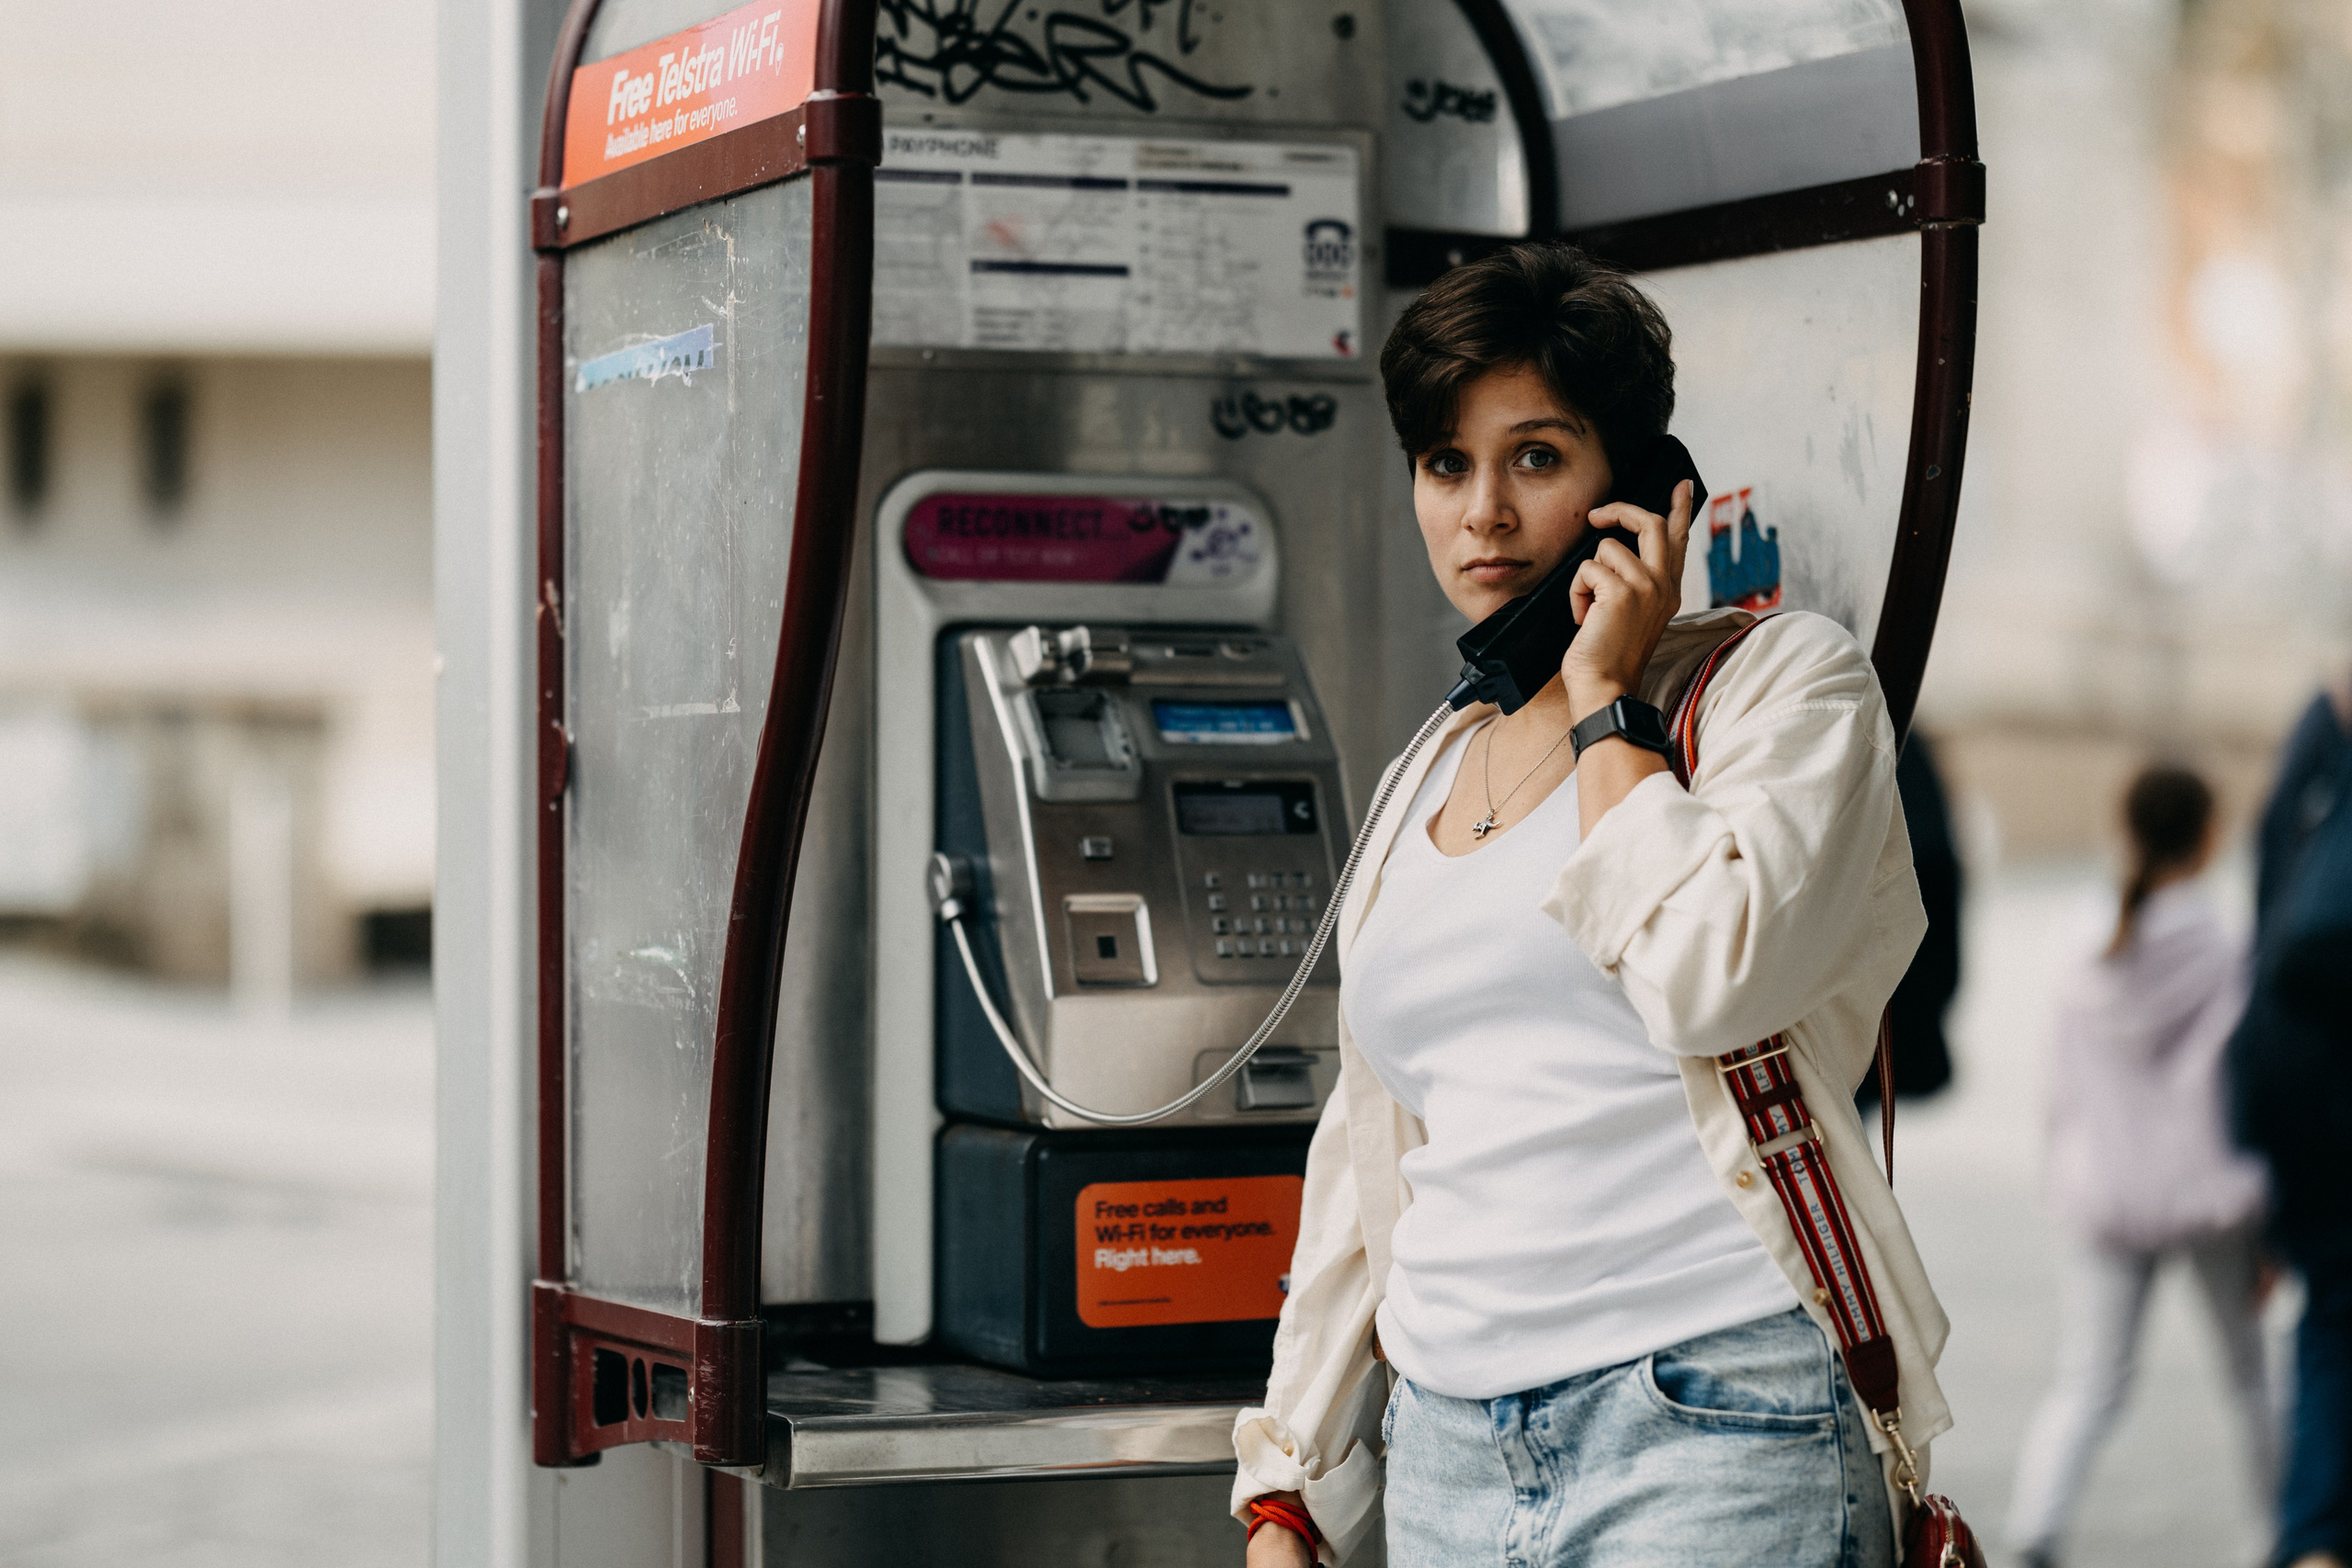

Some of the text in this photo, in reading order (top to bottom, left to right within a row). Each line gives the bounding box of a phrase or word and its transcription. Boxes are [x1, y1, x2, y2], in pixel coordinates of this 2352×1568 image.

[606, 69, 654, 126] Free
[655, 43, 725, 107] Telstra
[604, 96, 738, 162] Available here for everyone.
[1094, 1221, 1276, 1243] Wi-Fi for everyone.
[1095, 1196, 1228, 1220] Free calls and
[1094, 1246, 1203, 1272] Right here.
[1810, 1201, 1846, 1276] HILFIGER
[1840, 1284, 1871, 1343] TOMMY
